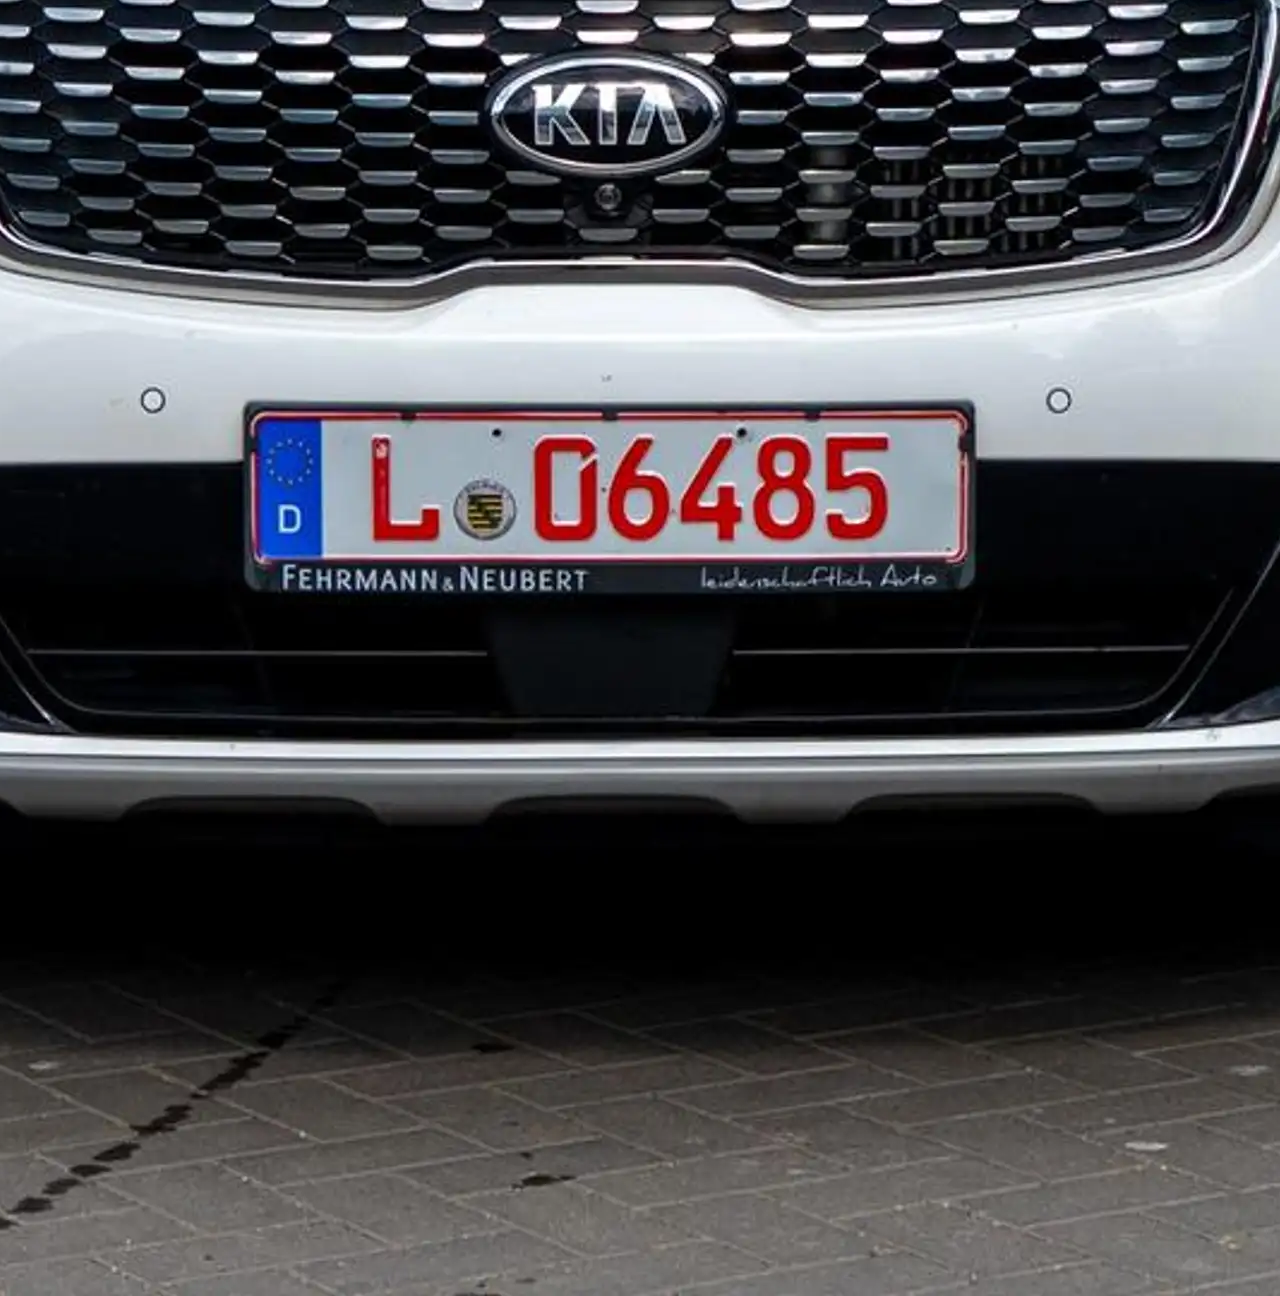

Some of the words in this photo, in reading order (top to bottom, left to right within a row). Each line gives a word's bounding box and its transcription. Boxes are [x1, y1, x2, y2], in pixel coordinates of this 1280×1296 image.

[531, 82, 687, 146] KIA
[370, 435, 440, 542] L
[532, 435, 890, 542] 06485
[277, 504, 302, 534] D
[879, 563, 938, 588] Auto
